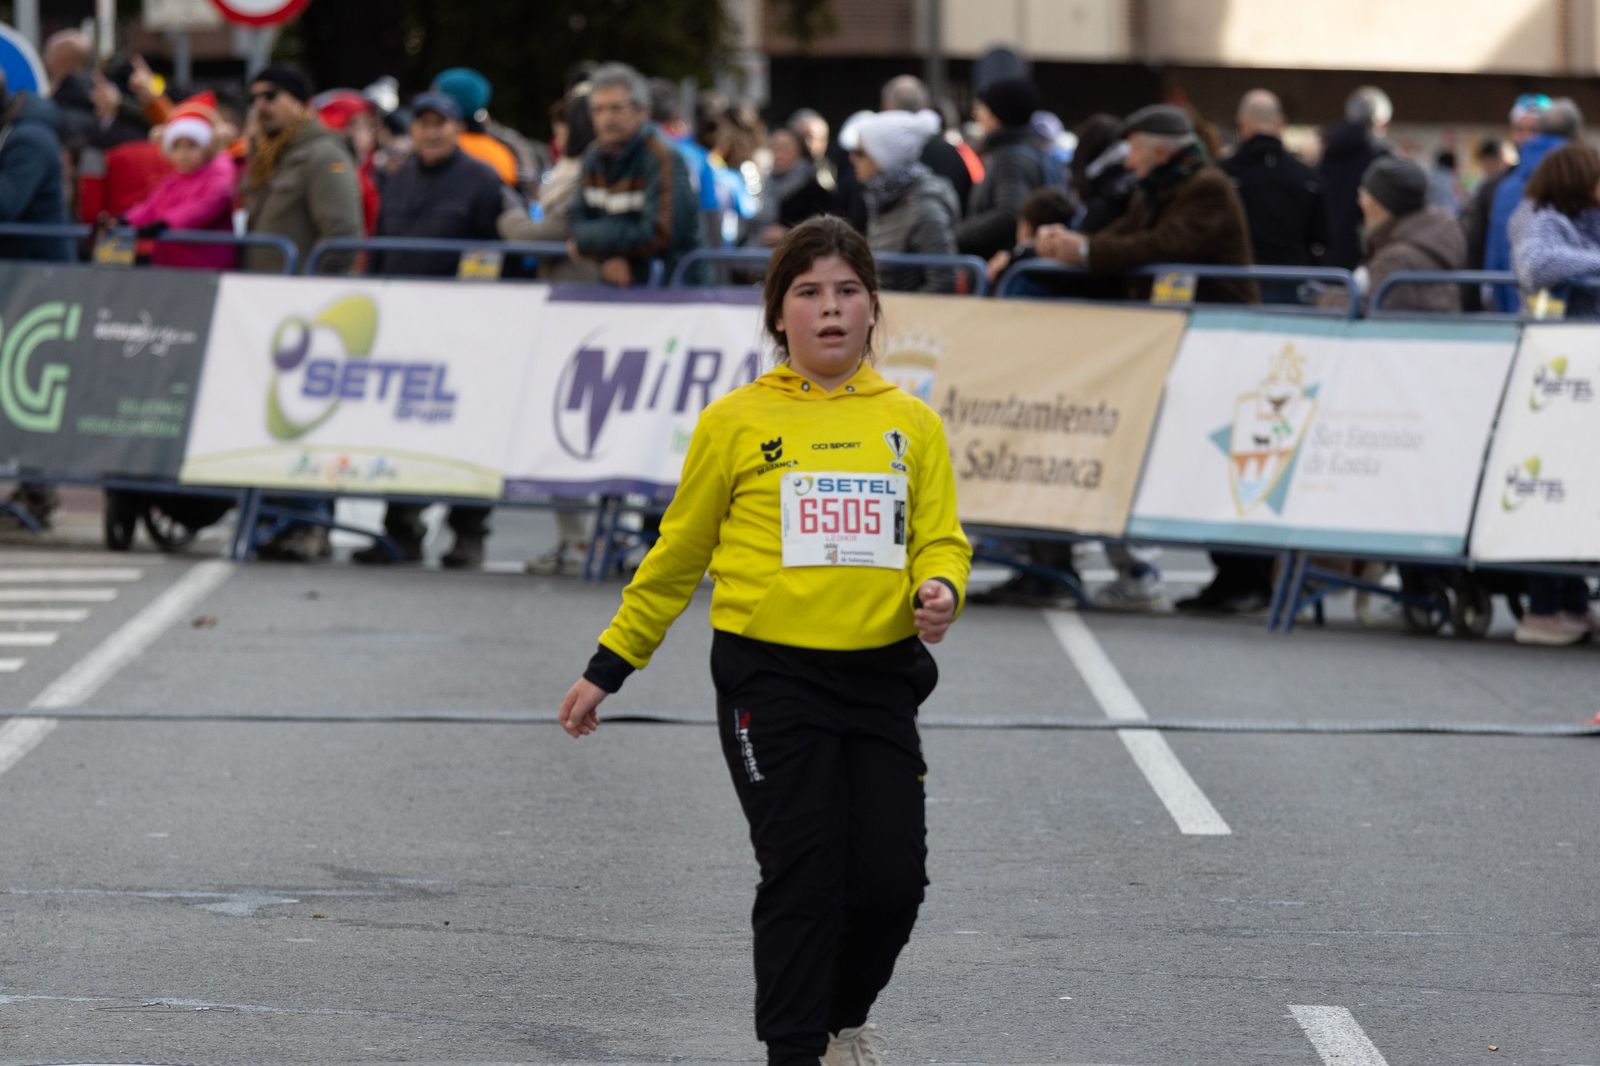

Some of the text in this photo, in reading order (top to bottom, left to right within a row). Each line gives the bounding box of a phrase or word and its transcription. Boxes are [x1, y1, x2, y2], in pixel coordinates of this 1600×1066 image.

[302, 359, 457, 401] SETEL
[939, 386, 1120, 437] Ayuntamiento
[830, 442, 862, 450] SPORT
[959, 437, 1103, 490] Salamanca
[817, 478, 896, 495] SETEL
[800, 498, 880, 535] 6505
